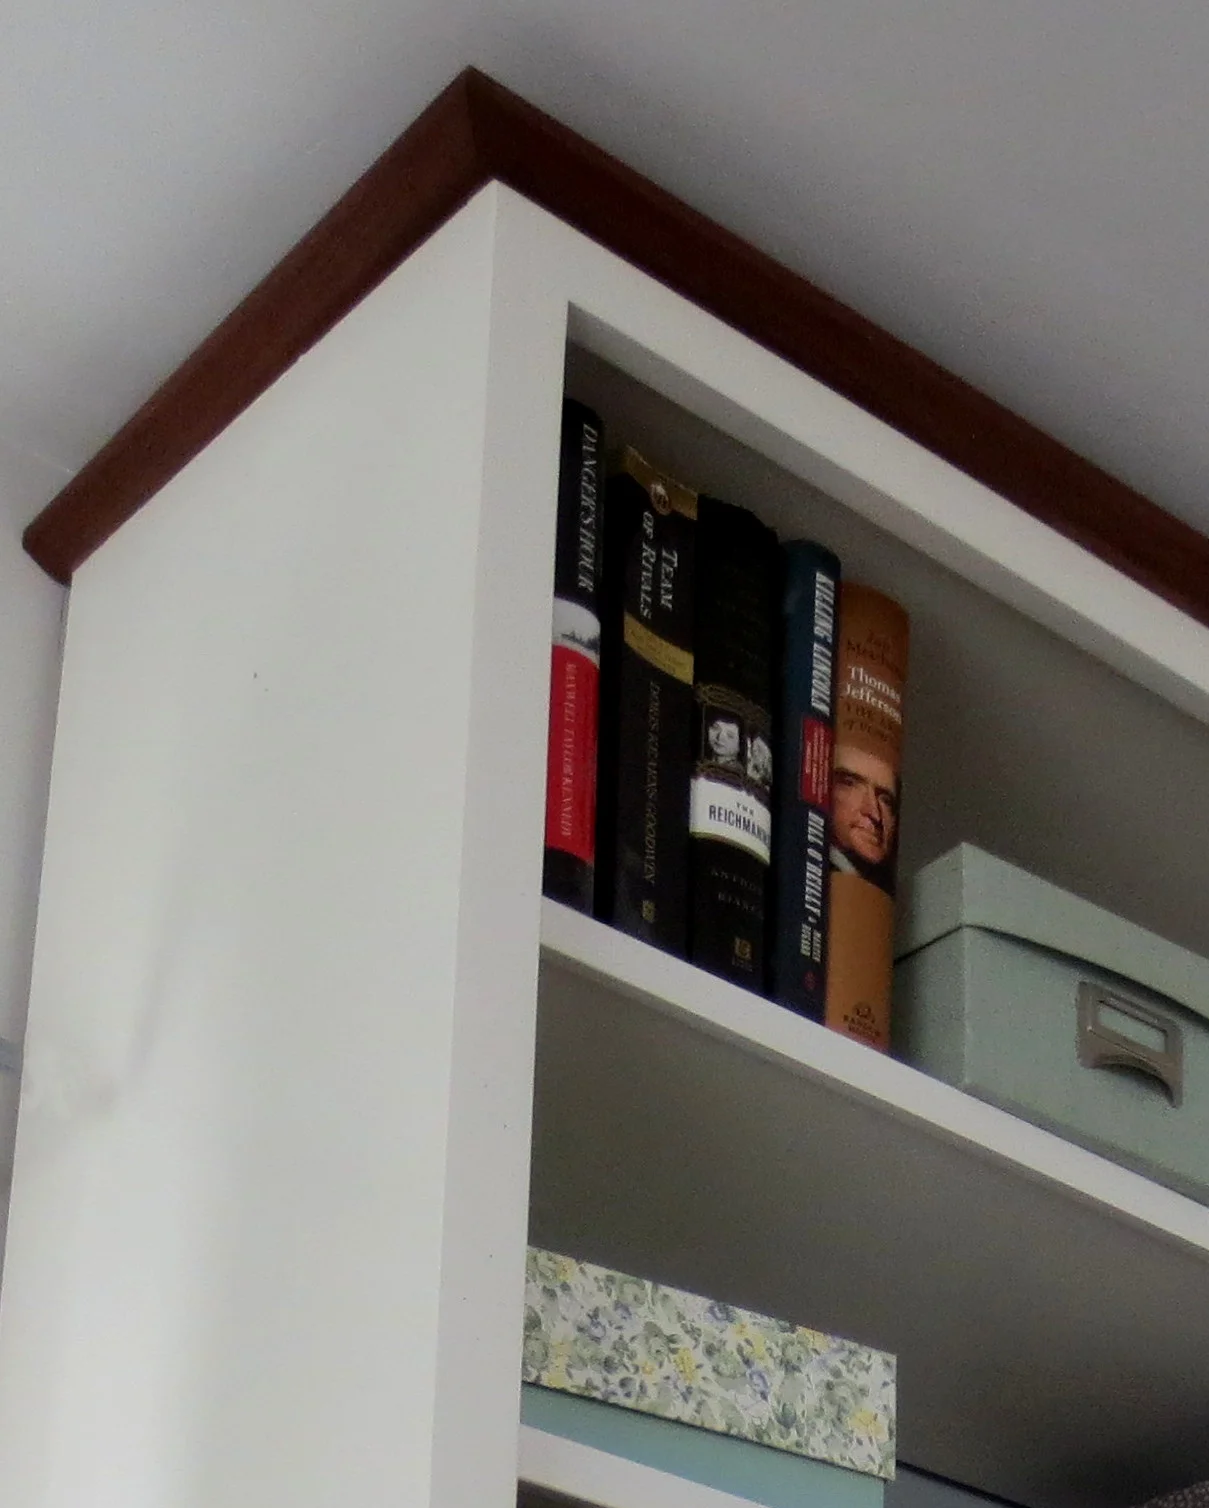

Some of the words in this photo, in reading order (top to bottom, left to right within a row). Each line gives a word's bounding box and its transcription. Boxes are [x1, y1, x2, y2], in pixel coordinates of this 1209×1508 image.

[639, 541, 657, 621] RIVALS
[659, 546, 679, 612] TEAM
[813, 570, 836, 641] KILLING
[810, 641, 833, 719] LINCOLN
